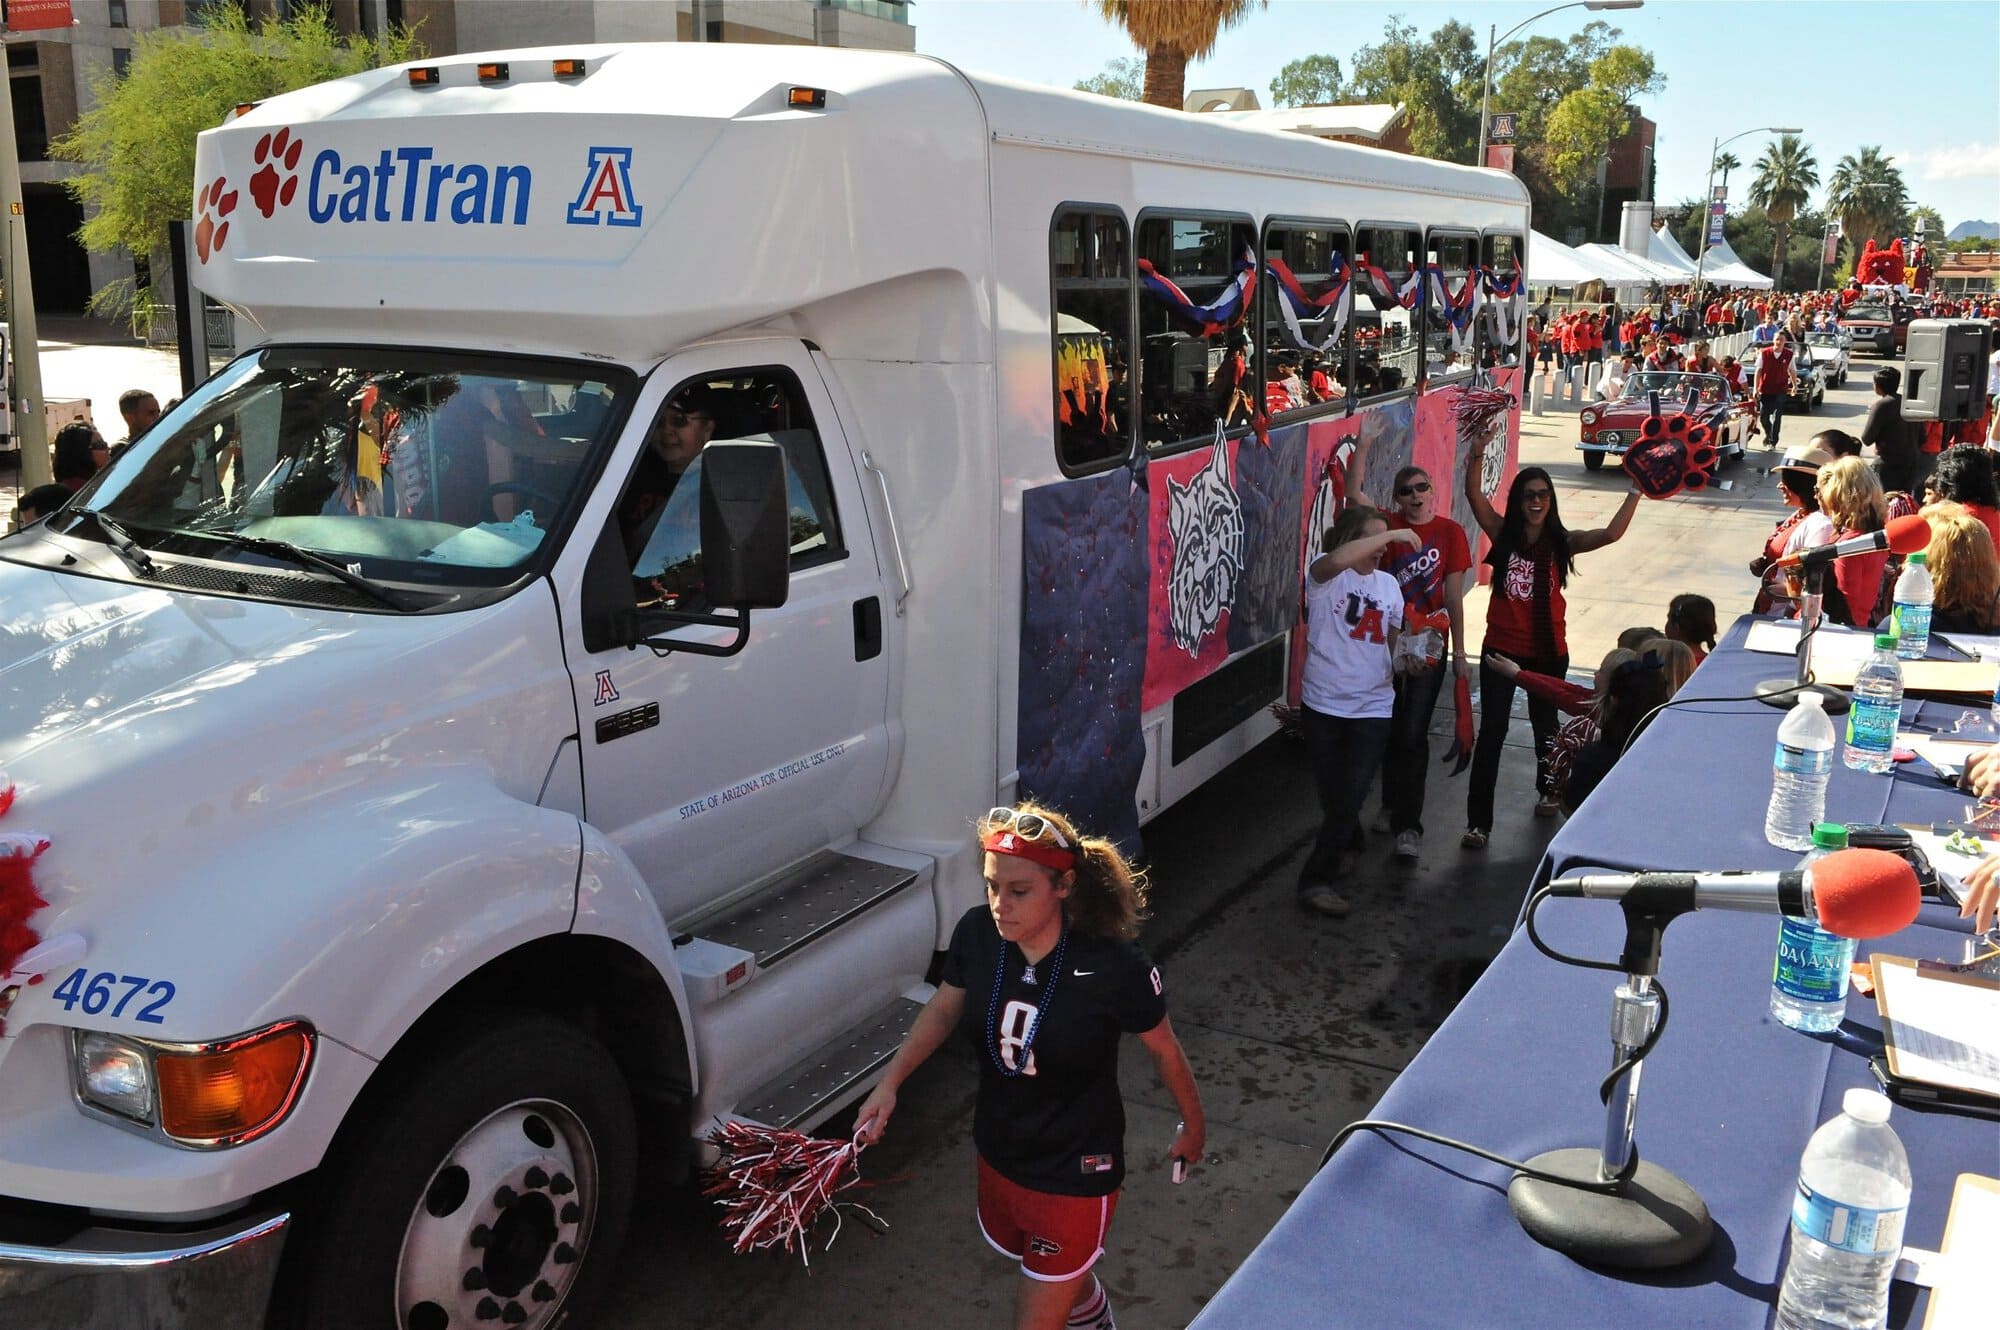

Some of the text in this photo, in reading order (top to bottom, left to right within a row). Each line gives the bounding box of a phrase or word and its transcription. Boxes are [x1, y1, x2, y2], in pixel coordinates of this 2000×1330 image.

[1492, 116, 1514, 138] A
[308, 147, 532, 225] CatTran
[566, 146, 643, 227] A
[594, 669, 620, 707] A
[679, 743, 847, 820] STATE OF ARIZONA FOR OFFICIAL USE ONLY
[1780, 941, 1841, 969] DASANI
[52, 967, 176, 1025] 4672
[1150, 966, 1162, 996] 8
